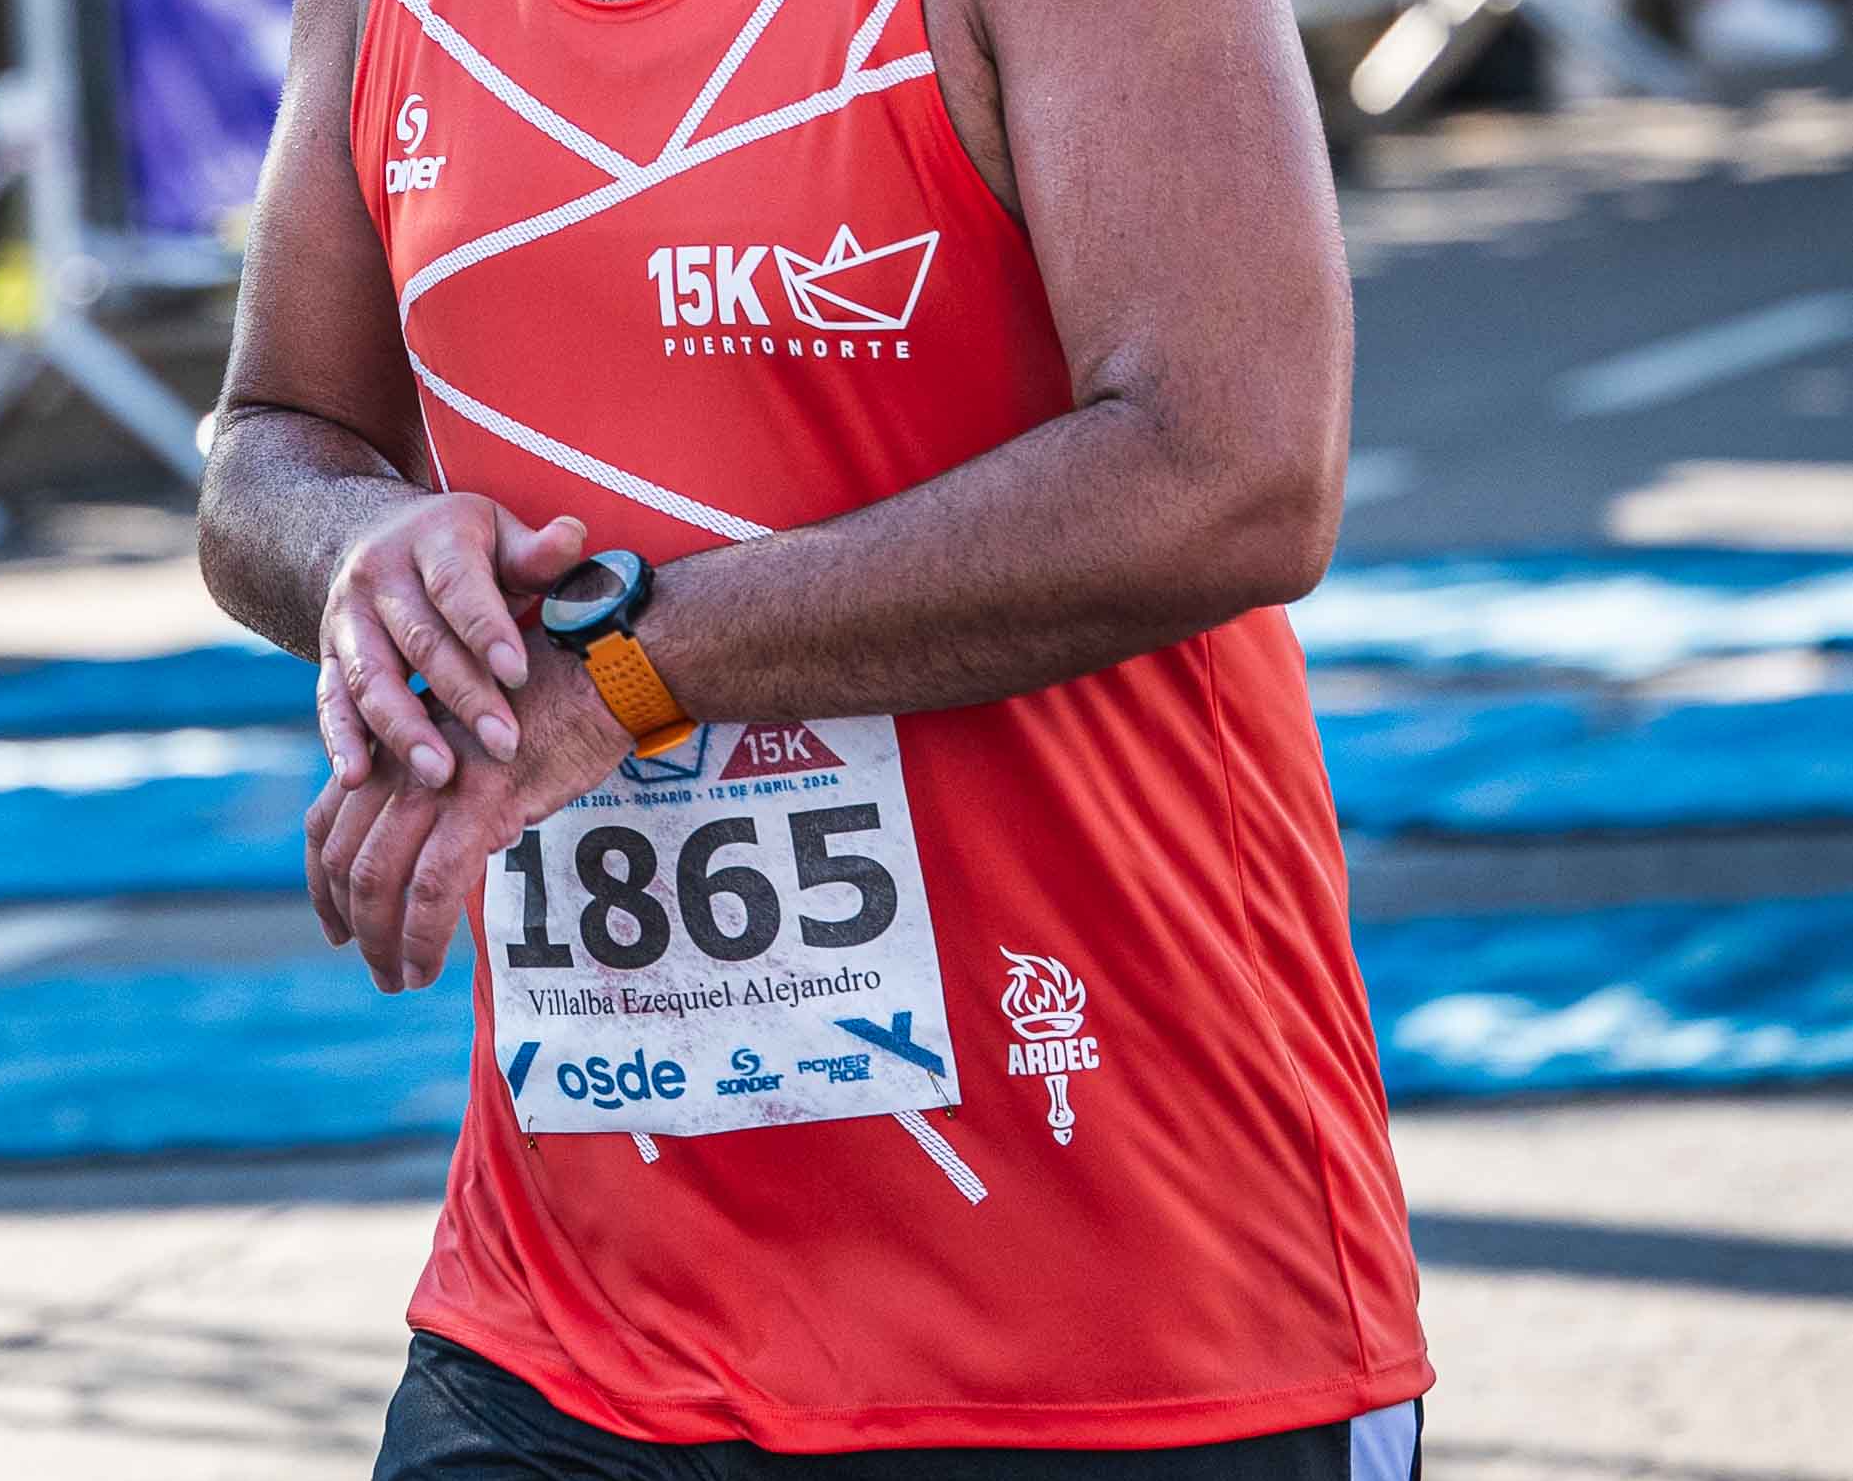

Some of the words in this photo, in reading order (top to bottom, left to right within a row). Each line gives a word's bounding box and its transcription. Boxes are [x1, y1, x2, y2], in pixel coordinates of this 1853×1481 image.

[647, 245, 771, 327] 15K
[664, 335, 775, 357] PUERTO
[788, 338, 911, 359] NORTE
[743, 728, 813, 766] 15K
[634, 789, 693, 806] ROSARIO
[708, 787, 725, 800] 12
[730, 784, 748, 798] DE
[754, 779, 798, 796] ABRIL
[803, 773, 839, 789] 2026
[504, 802, 898, 971] 1865
[528, 988, 616, 1017] Villalba
[622, 981, 733, 1020] Ezequiel
[743, 966, 882, 1009] Alejandro
[556, 1048, 687, 1102] osde
[797, 1053, 871, 1075] POWER
[1008, 1036, 1100, 1076] ARDEC
